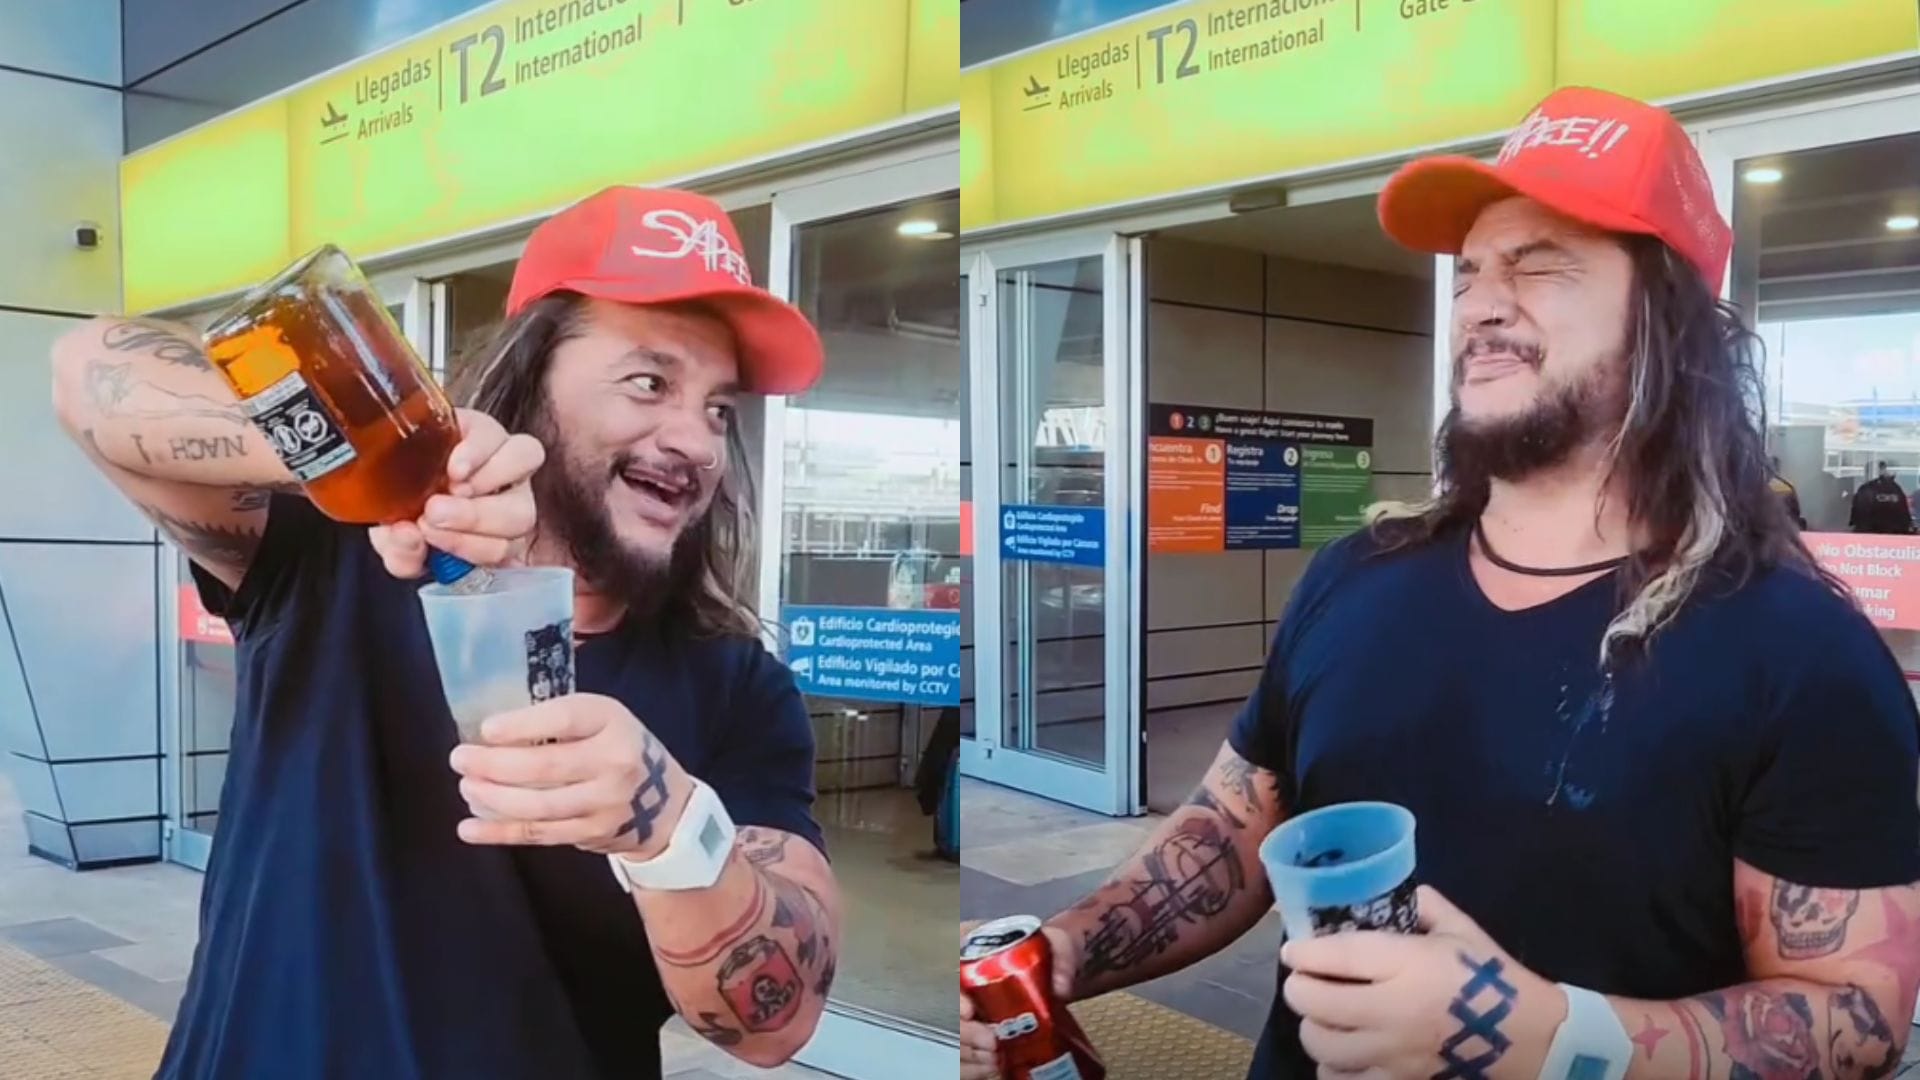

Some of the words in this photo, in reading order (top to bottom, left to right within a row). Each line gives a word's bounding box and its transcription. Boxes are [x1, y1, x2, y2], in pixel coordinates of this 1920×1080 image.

[515, 0, 626, 43] Internac
[515, 13, 642, 84] International
[1147, 18, 1200, 84] T2
[1208, 18, 1324, 71] International
[450, 24, 506, 104] T2
[1057, 42, 1130, 79] Llegadas
[356, 57, 432, 105] Llegadas
[1059, 79, 1113, 110] Arrivals
[357, 102, 414, 140] Arrivals
[1186, 416, 1195, 428] 2
[1226, 443, 1264, 458] Registra
[1200, 502, 1222, 514] Find
[1277, 504, 1298, 516] Drop
[1817, 544, 1840, 558] No
[1840, 561, 1864, 577] Not
[1867, 562, 1903, 580] Block
[818, 616, 863, 631] Edificio
[819, 635, 904, 652] Cardioprotected
[905, 639, 933, 652] Area
[817, 654, 862, 671] Edificio
[864, 657, 918, 676] Vigilado
[920, 663, 945, 679] por
[947, 663, 960, 678] C
[817, 673, 842, 687] Area
[844, 677, 900, 692] monitored
[902, 679, 918, 695] by
[919, 680, 951, 696] CCTV
